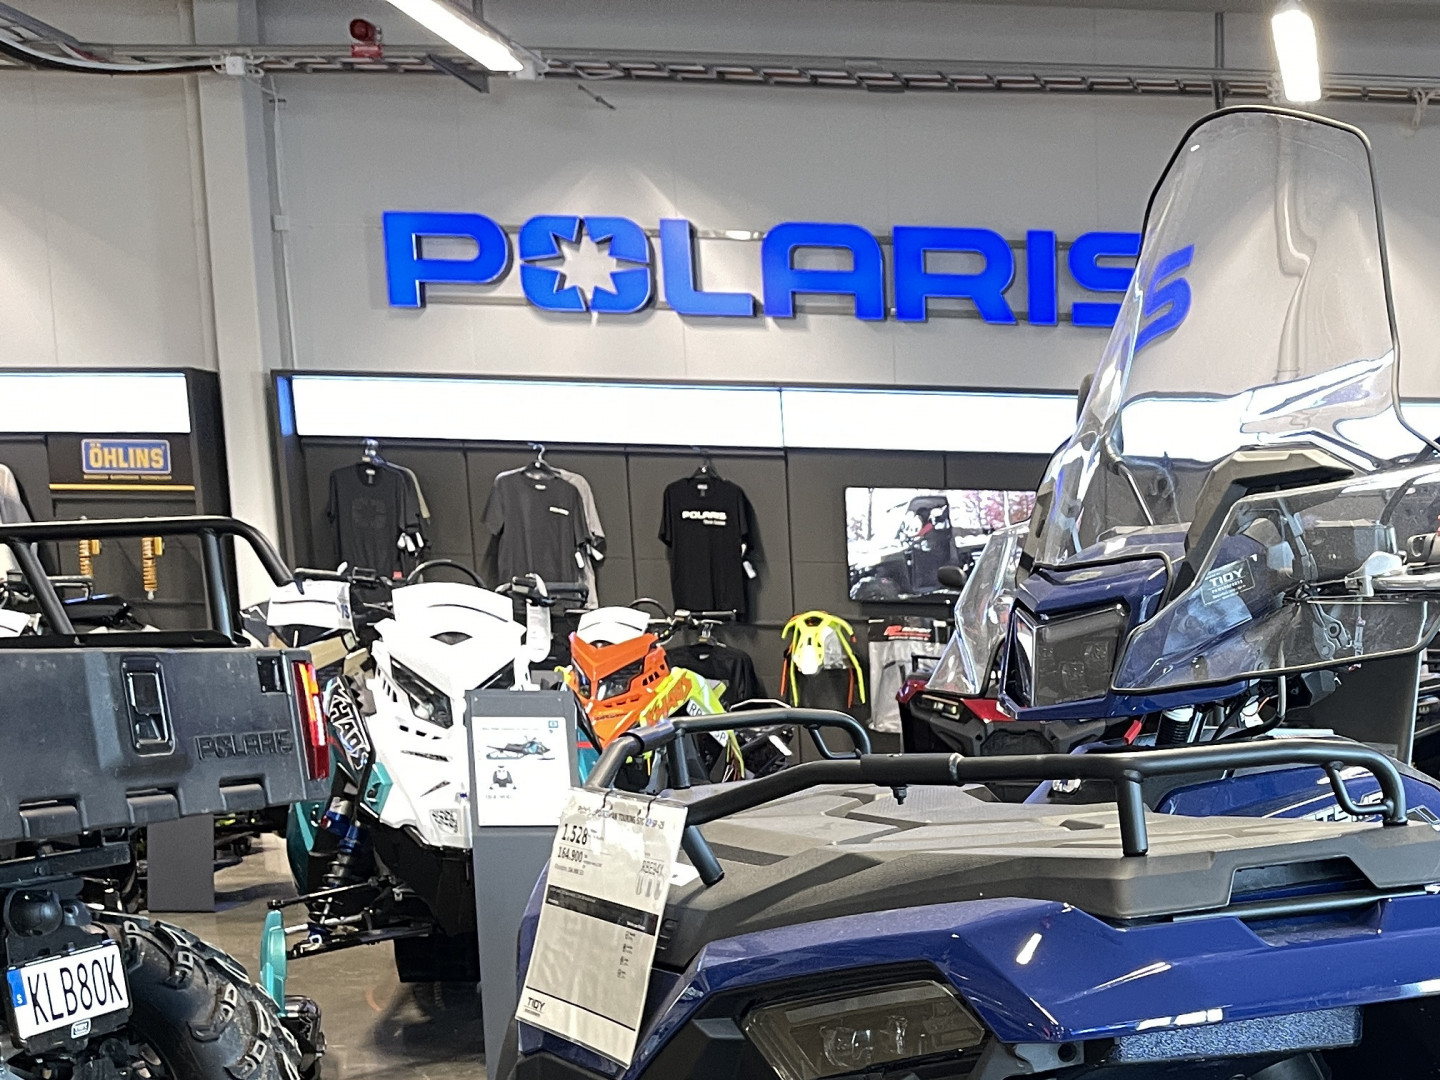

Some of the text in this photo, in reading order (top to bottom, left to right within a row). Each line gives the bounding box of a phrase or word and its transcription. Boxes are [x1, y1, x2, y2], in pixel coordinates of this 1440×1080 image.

[384, 211, 1194, 343] POLARIS
[88, 442, 164, 468] ÖHLINS
[681, 510, 727, 521] POLARIS
[1208, 567, 1244, 587] TIDY
[195, 730, 294, 760] POLARIS
[561, 823, 588, 845] 1.528
[557, 846, 583, 863] 164.900
[28, 954, 124, 1025] KLB80K
[527, 996, 546, 1012] TIDY
